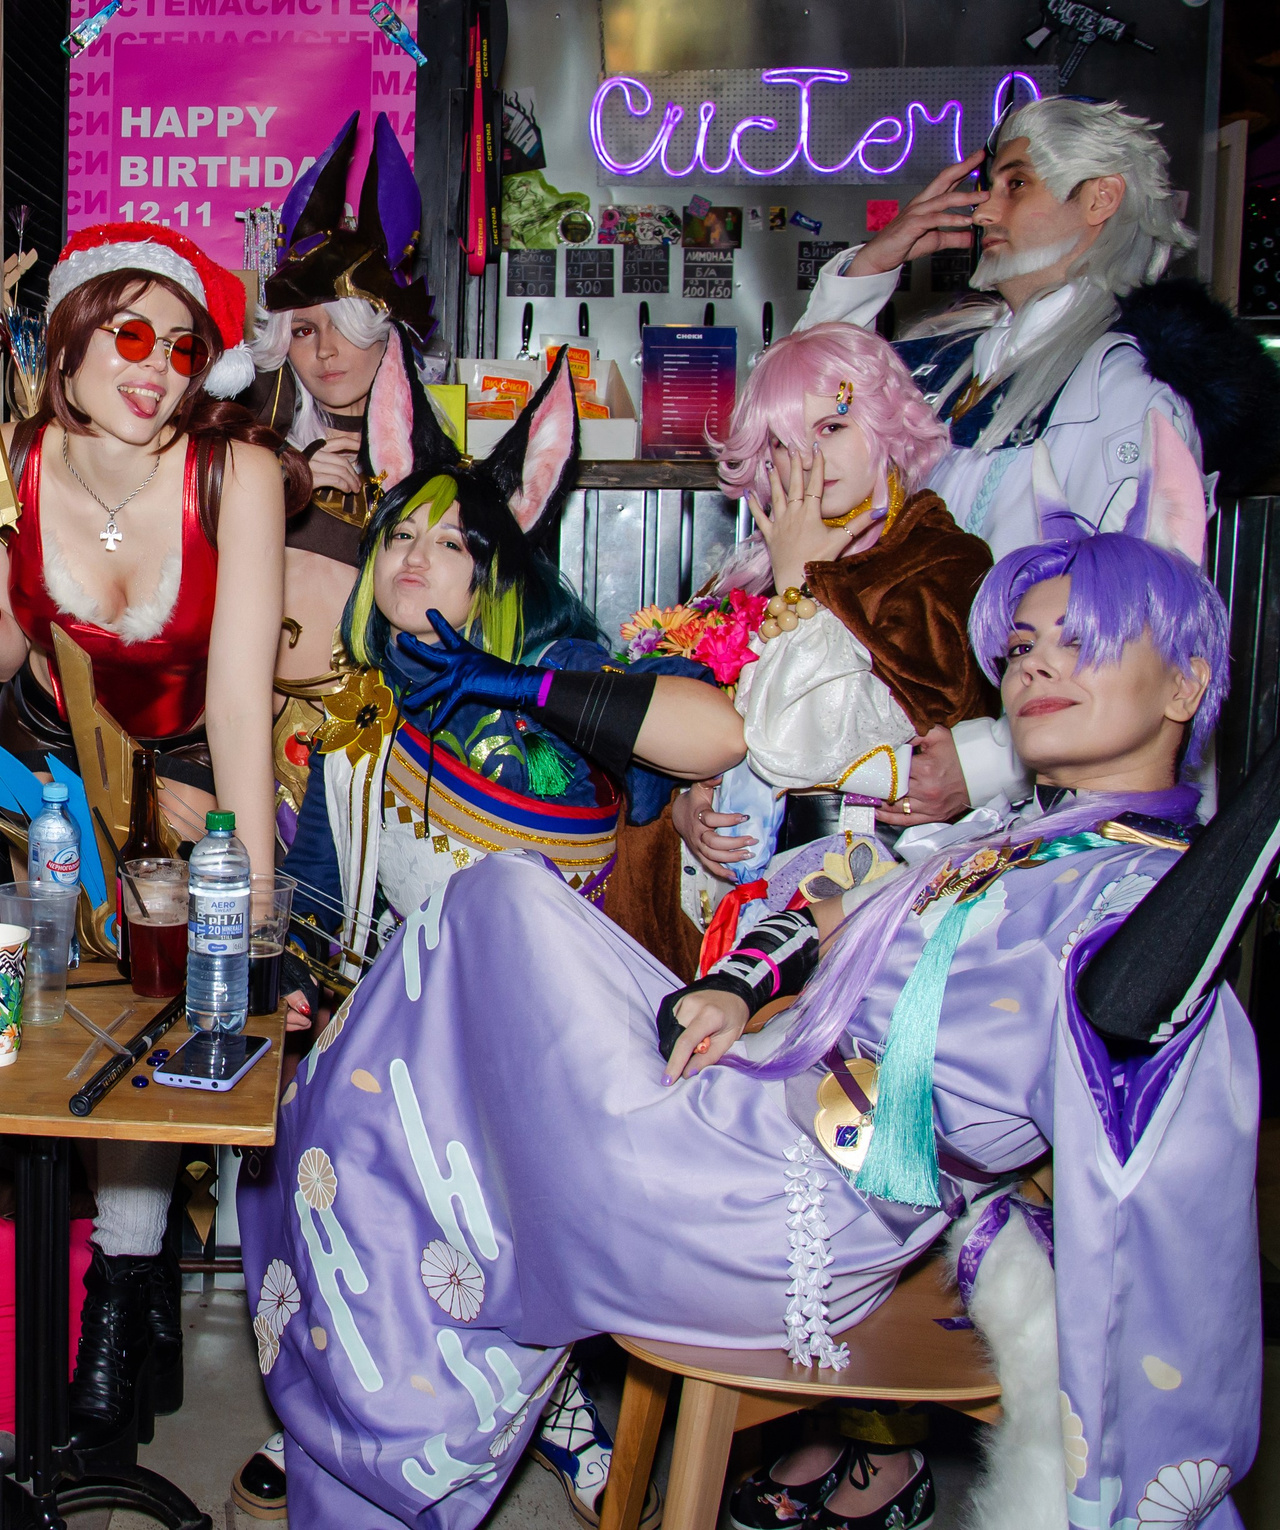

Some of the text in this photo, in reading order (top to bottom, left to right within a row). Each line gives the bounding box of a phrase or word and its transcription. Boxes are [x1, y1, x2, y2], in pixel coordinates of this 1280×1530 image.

[121, 106, 277, 138] HAPPY
[120, 156, 318, 188] BIRTHDA
[685, 251, 733, 262] ЛИМОНАД
[514, 282, 549, 296] 300
[575, 280, 602, 296] 300
[633, 278, 662, 293] 300
[684, 286, 731, 298] 100 150
[196, 898, 207, 949] NATURAL
[208, 914, 243, 926] pH 7.1
[208, 926, 221, 935] 20
